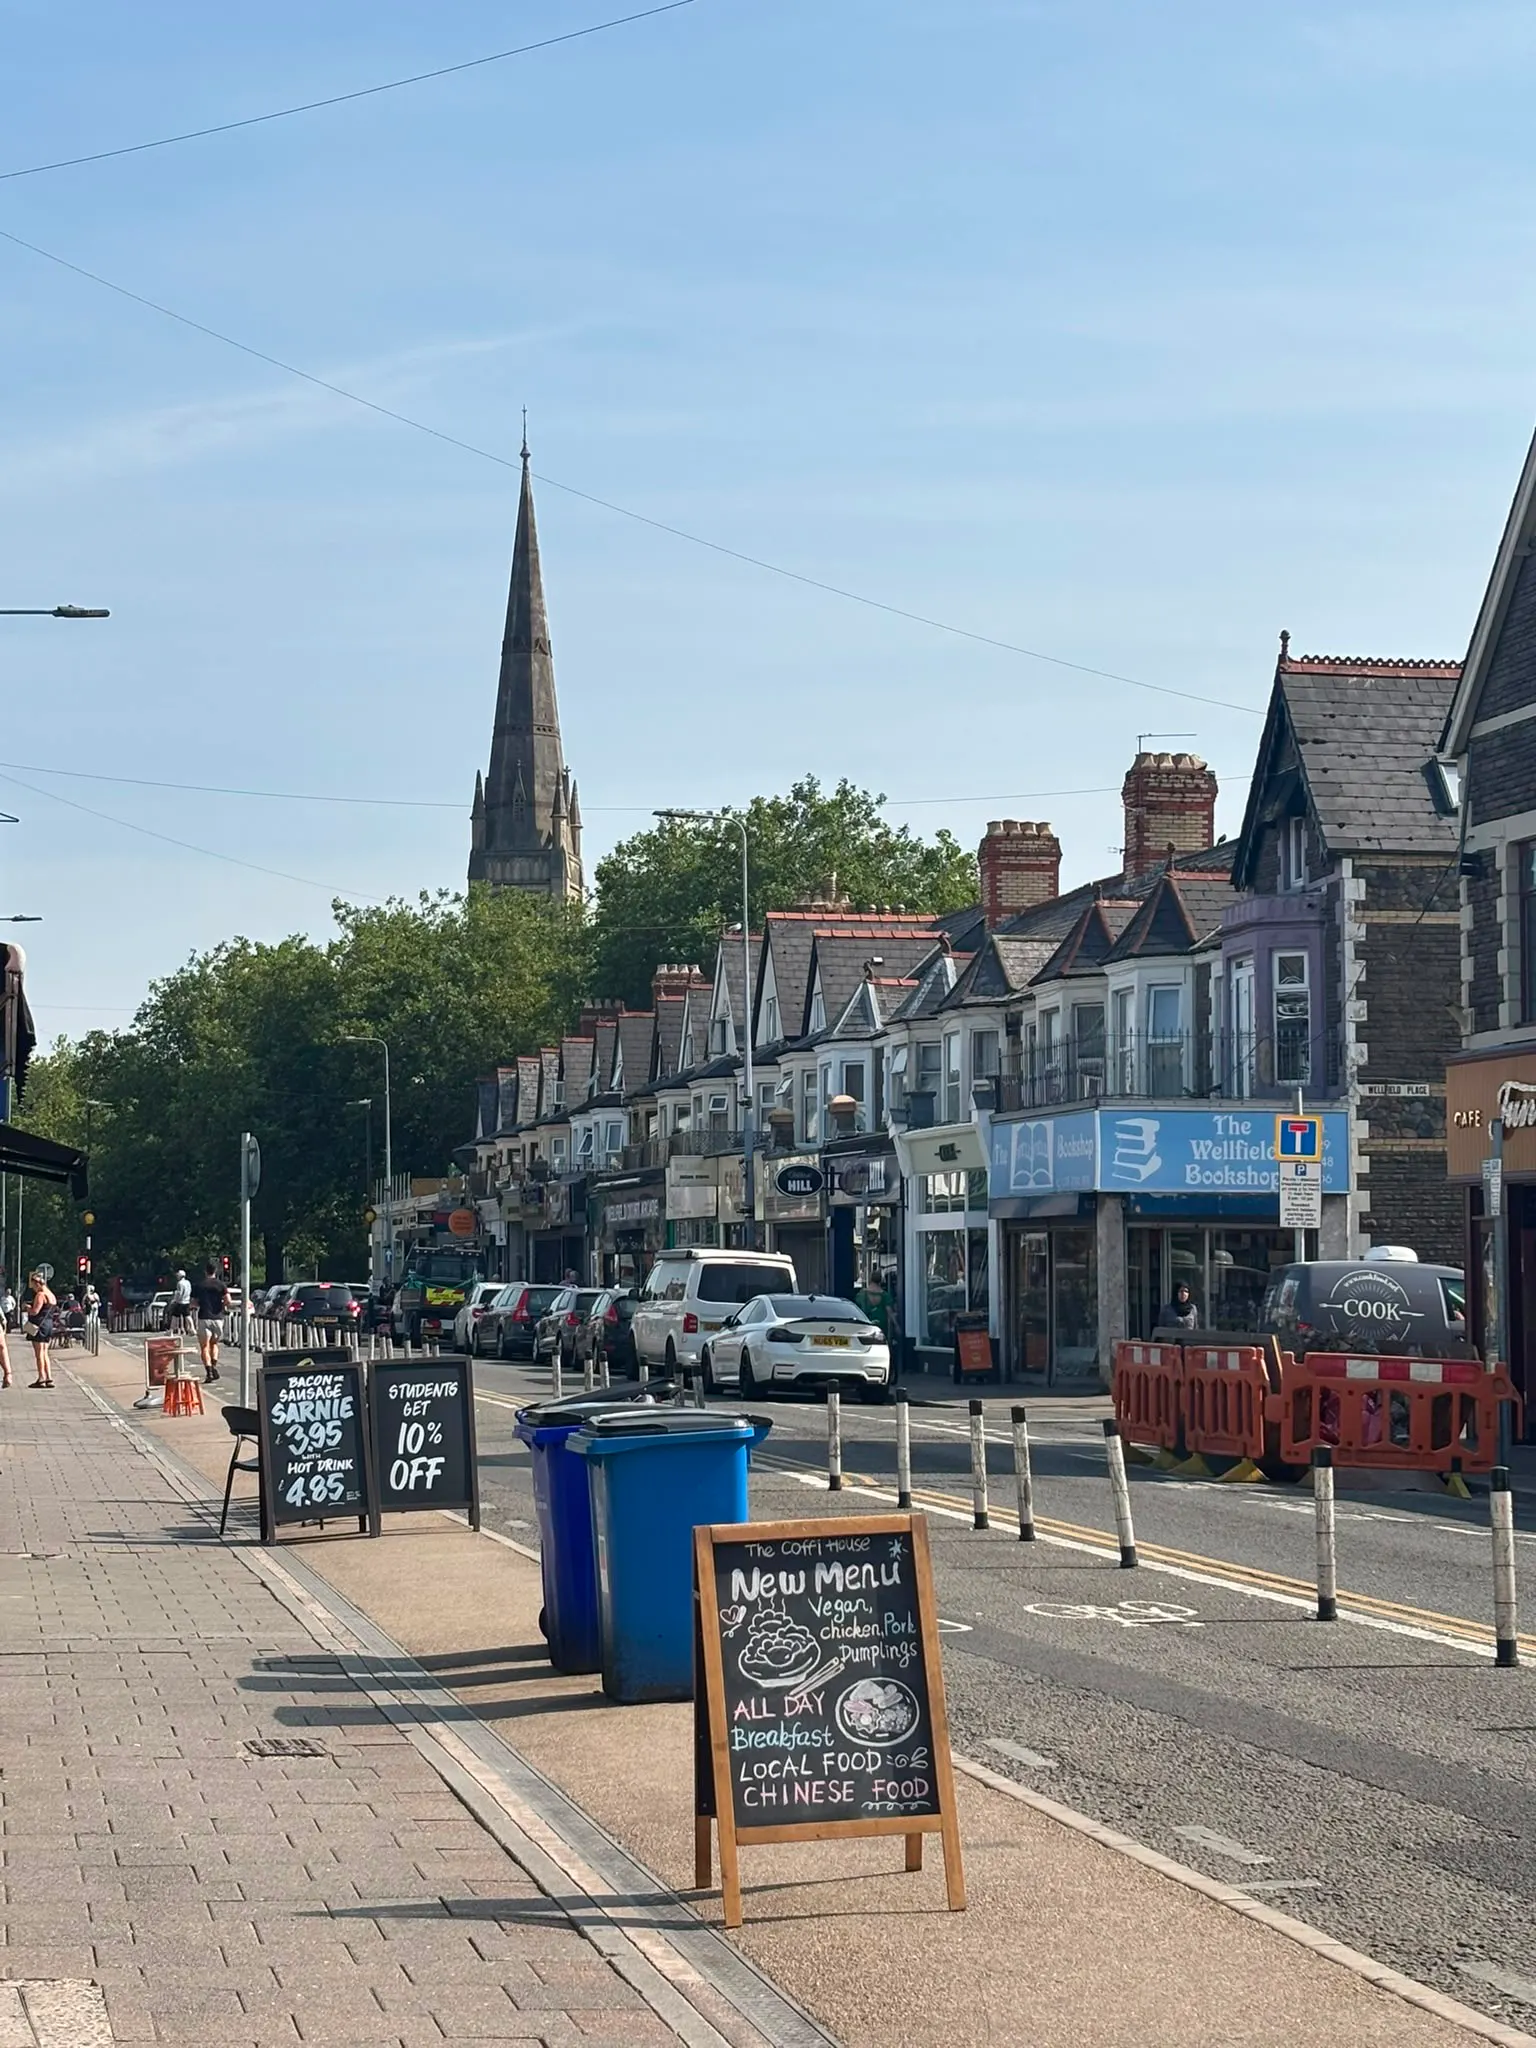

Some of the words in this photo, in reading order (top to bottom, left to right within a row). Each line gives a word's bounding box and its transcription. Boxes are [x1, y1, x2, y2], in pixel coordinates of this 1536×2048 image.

[1406, 1085, 1428, 1095] PLACE
[1213, 1114, 1253, 1136] The
[1453, 1109, 1481, 1128] CAFE
[1056, 1134, 1095, 1161] Bookshop
[787, 1179, 813, 1192] HILL
[1185, 1163, 1279, 1191] Bookshop
[1343, 1298, 1401, 1321] COOK
[279, 1383, 343, 1402] SAUSAGE
[288, 1374, 334, 1388] BACON
[388, 1381, 459, 1399] STUDENTS
[271, 1395, 354, 1425] SARNIE
[403, 1400, 431, 1417] GET
[398, 1421, 443, 1455] 10%
[287, 1461, 314, 1474] HOT
[317, 1458, 354, 1472] DRINK
[389, 1456, 446, 1491] OFF
[744, 1543, 776, 1558] The
[781, 1539, 822, 1557] Coffi
[825, 1536, 871, 1553] House
[731, 1566, 806, 1601] New
[814, 1560, 902, 1594] Menu
[808, 1596, 873, 1624] Vegan,
[838, 1640, 918, 1668] Dumplings
[733, 1696, 776, 1721] ALL
[783, 1690, 826, 1718] DAY
[730, 1720, 836, 1751] Breakfast
[739, 1754, 814, 1782] LOCAL
[822, 1747, 883, 1776] FOOD
[743, 1780, 855, 1808] CHINESE
[871, 1775, 929, 1802] FOOD
